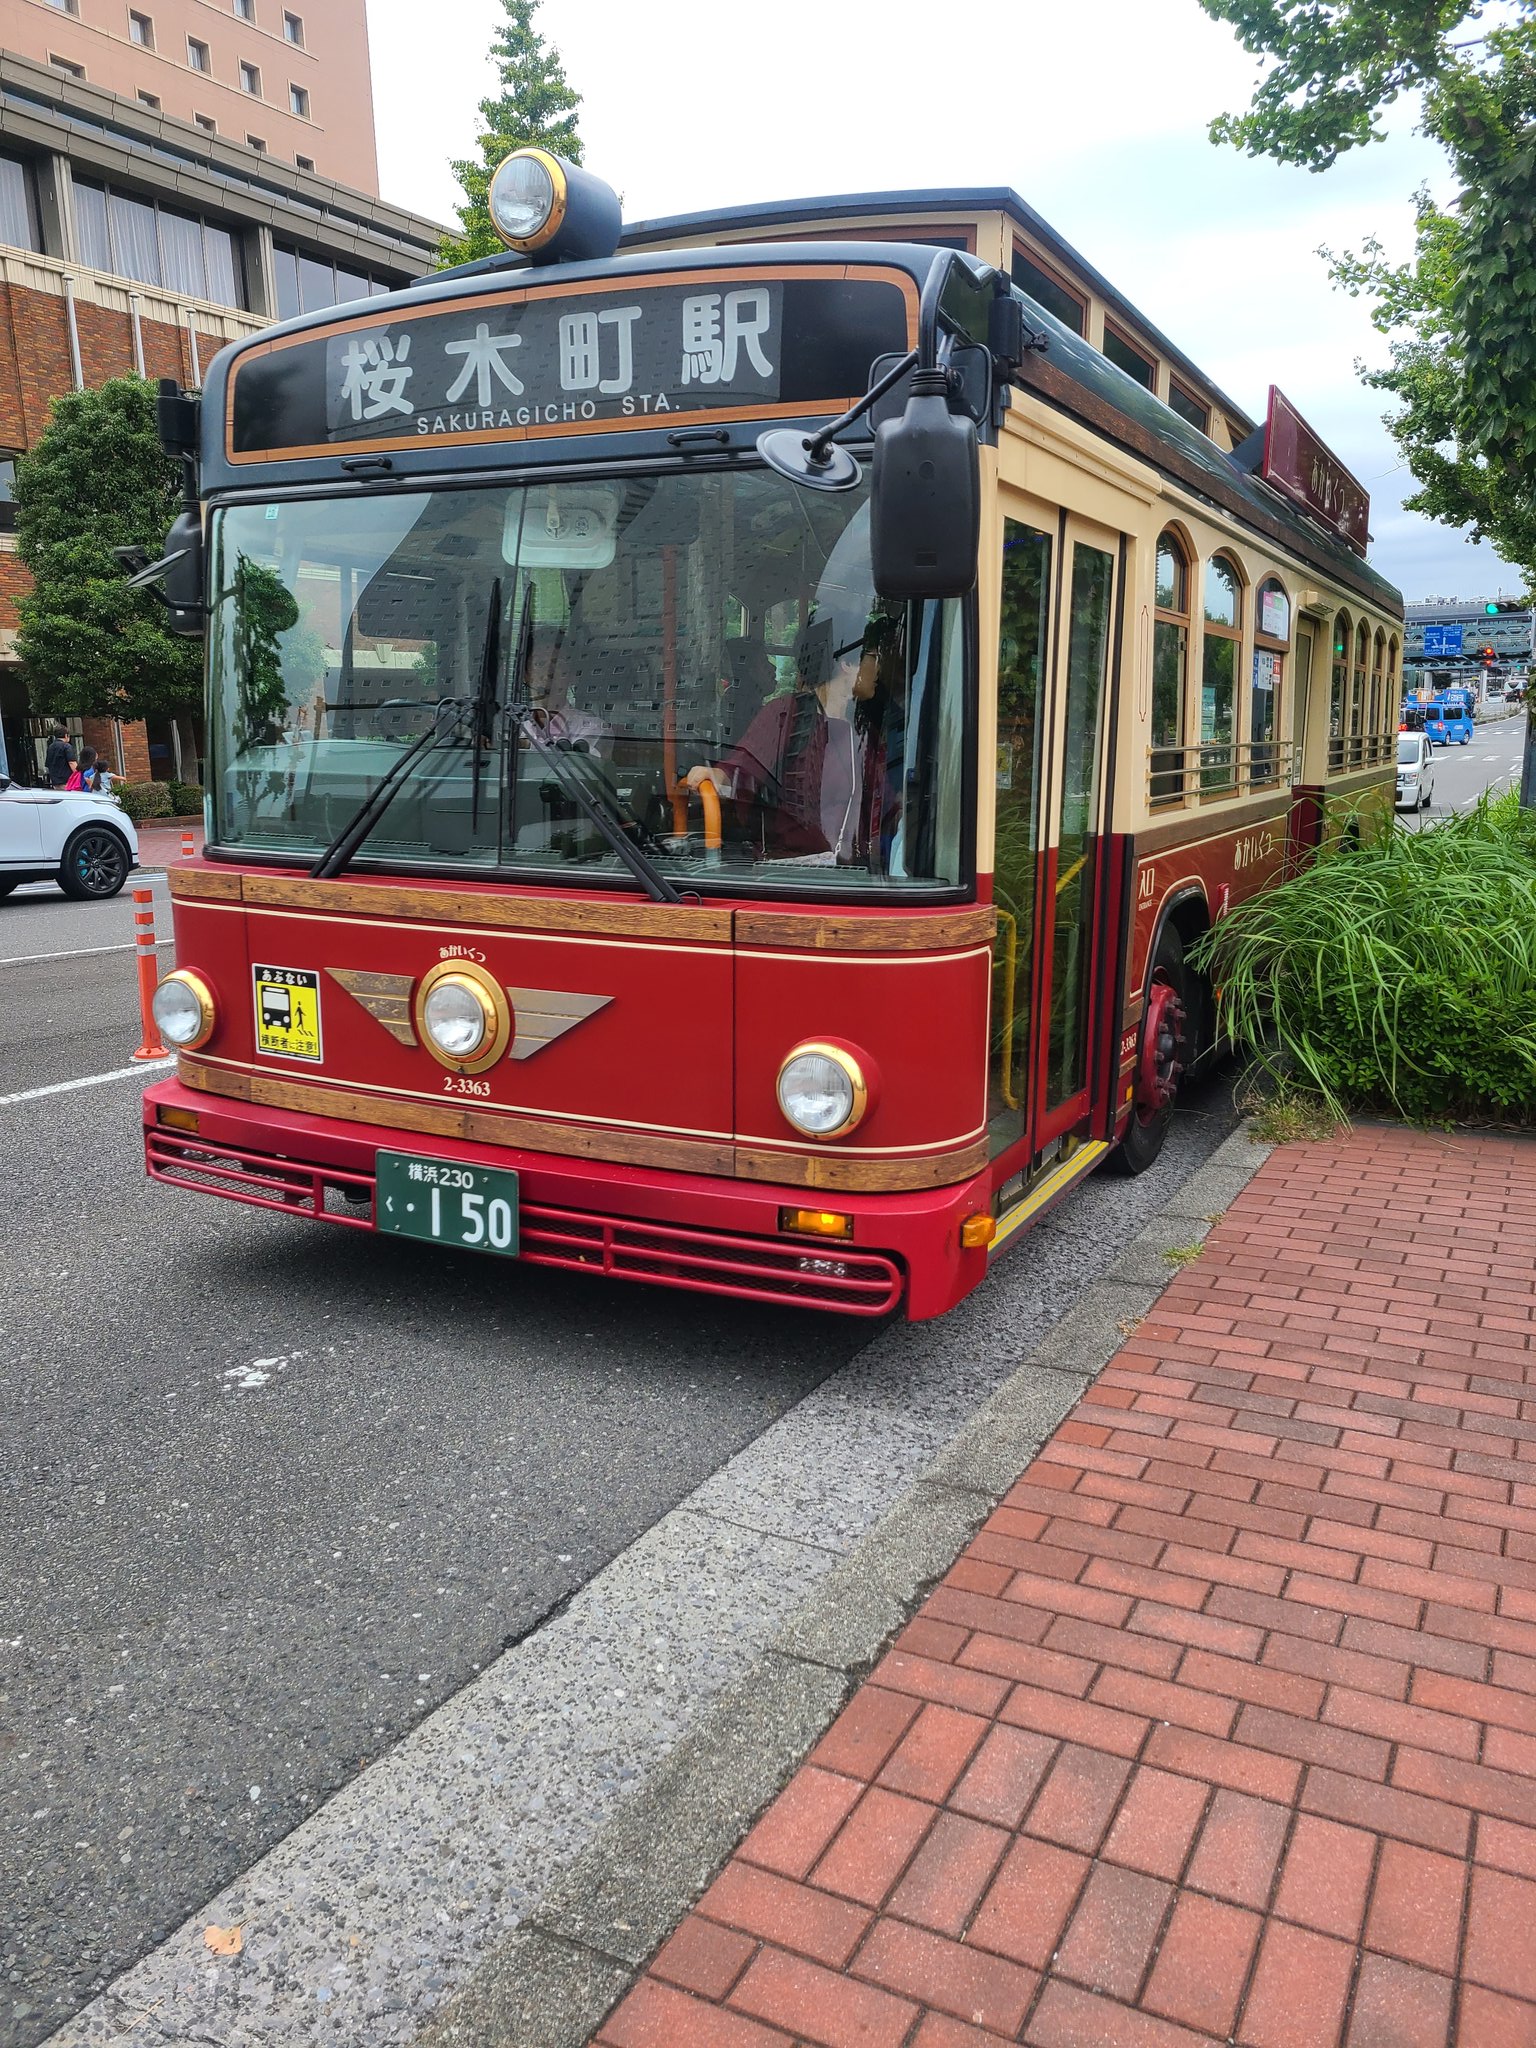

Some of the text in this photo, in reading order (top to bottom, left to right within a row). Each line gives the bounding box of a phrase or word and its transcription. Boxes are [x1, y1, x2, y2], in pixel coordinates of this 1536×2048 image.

[341, 287, 774, 421] 桜木町駅
[417, 392, 682, 436] SAKURAGICHO STA.
[1138, 867, 1155, 900] 入口
[438, 944, 487, 963] あかいくつ
[262, 969, 308, 986] あぶない
[443, 1076, 491, 1097] 2-3363
